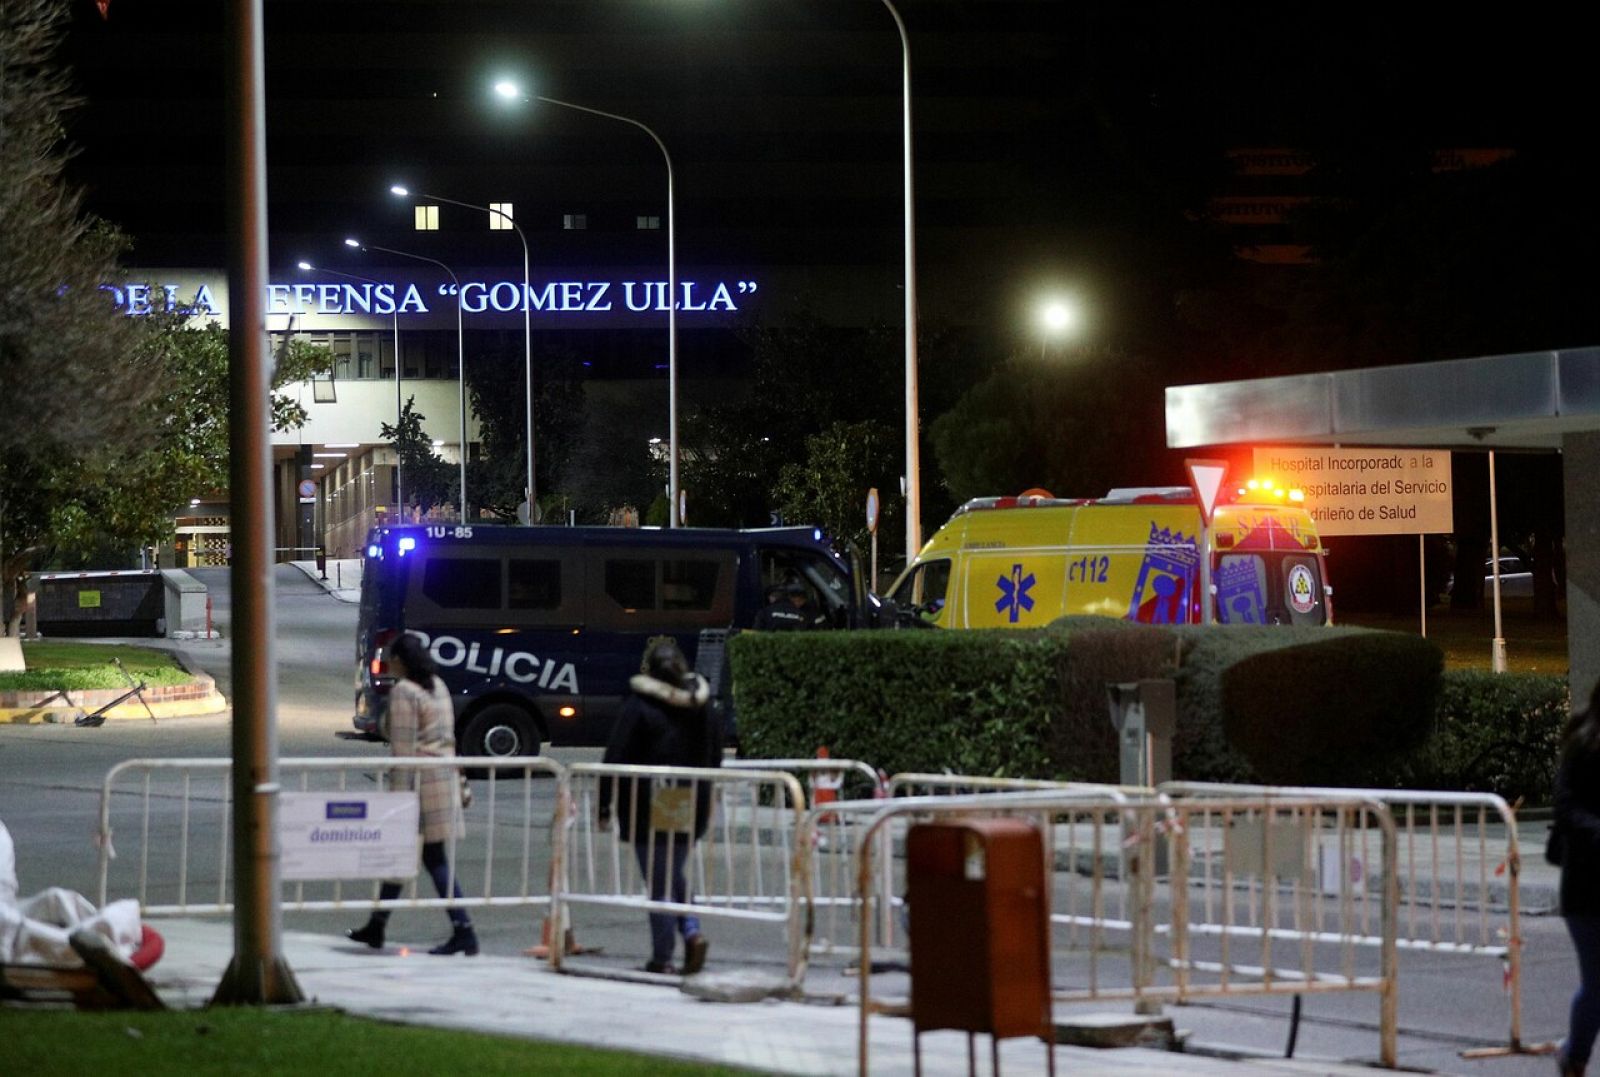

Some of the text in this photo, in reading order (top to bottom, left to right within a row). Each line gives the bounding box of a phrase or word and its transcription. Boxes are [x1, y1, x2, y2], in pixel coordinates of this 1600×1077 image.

[266, 283, 429, 314] EFENSA
[1271, 456, 1323, 473] Hospital
[1409, 457, 1417, 469] a
[1422, 454, 1434, 469] la
[1370, 480, 1391, 495] del
[1394, 479, 1447, 494] Servicio
[1310, 504, 1417, 521] drileño de Salud
